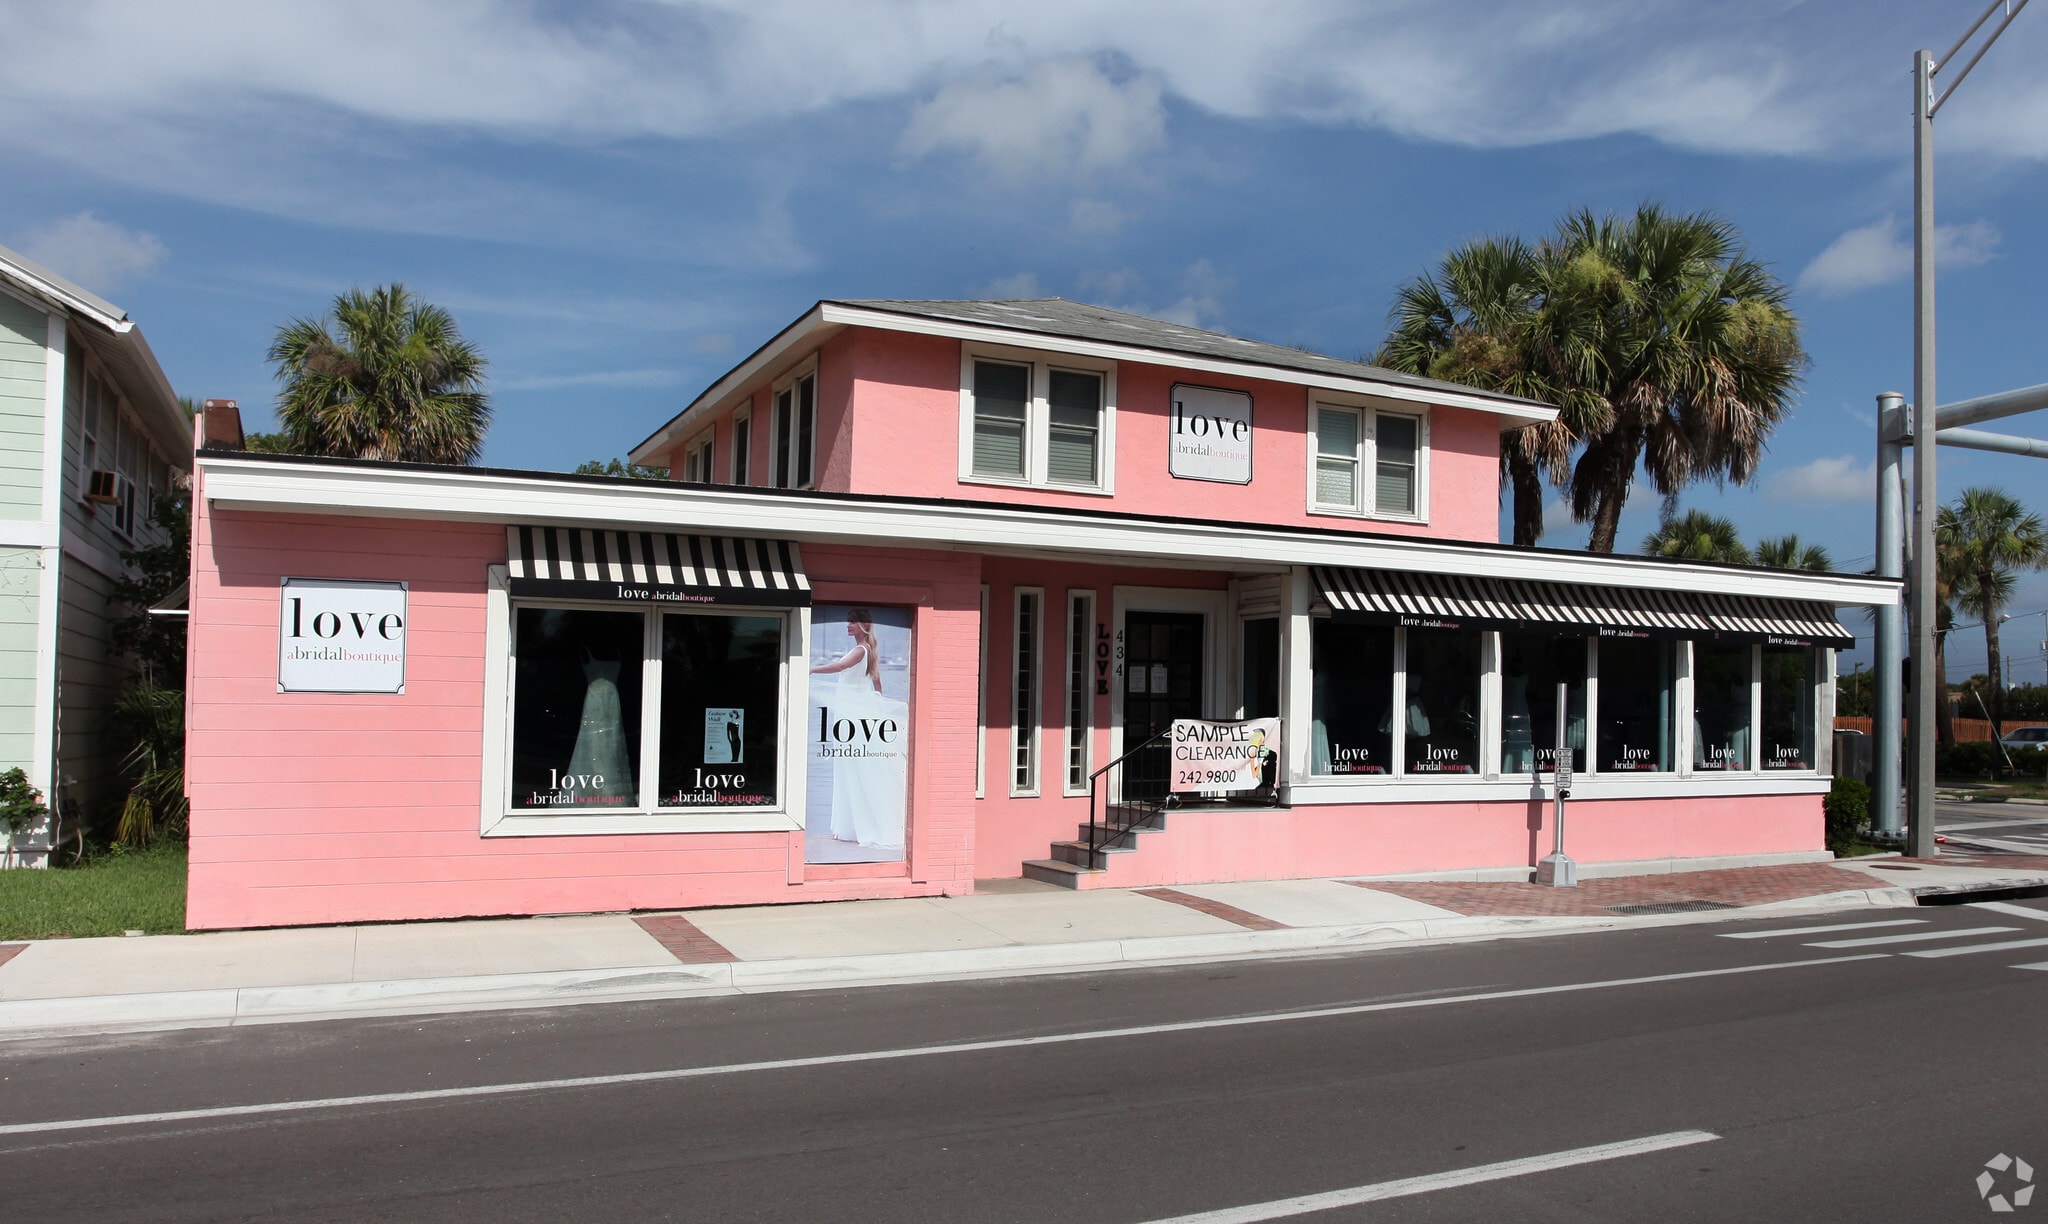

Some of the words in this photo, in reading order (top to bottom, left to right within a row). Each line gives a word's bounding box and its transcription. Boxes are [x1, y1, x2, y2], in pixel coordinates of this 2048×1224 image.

[1174, 401, 1248, 442] love
[617, 585, 649, 599] love
[287, 597, 403, 640] love
[1400, 615, 1420, 626] love
[1599, 626, 1616, 636] love
[1096, 623, 1110, 695] LOVE
[1116, 629, 1124, 676] 434
[816, 706, 898, 743] love
[1175, 724, 1249, 742] SAMPLE
[1175, 744, 1267, 760] CLEARANCE
[1334, 743, 1369, 760] love
[1426, 743, 1458, 760] love
[1623, 744, 1650, 759] love
[1710, 744, 1735, 759] love
[1776, 744, 1799, 758] love
[549, 768, 604, 789] love
[693, 768, 745, 789] love
[1179, 770, 1236, 784] 242.9800
